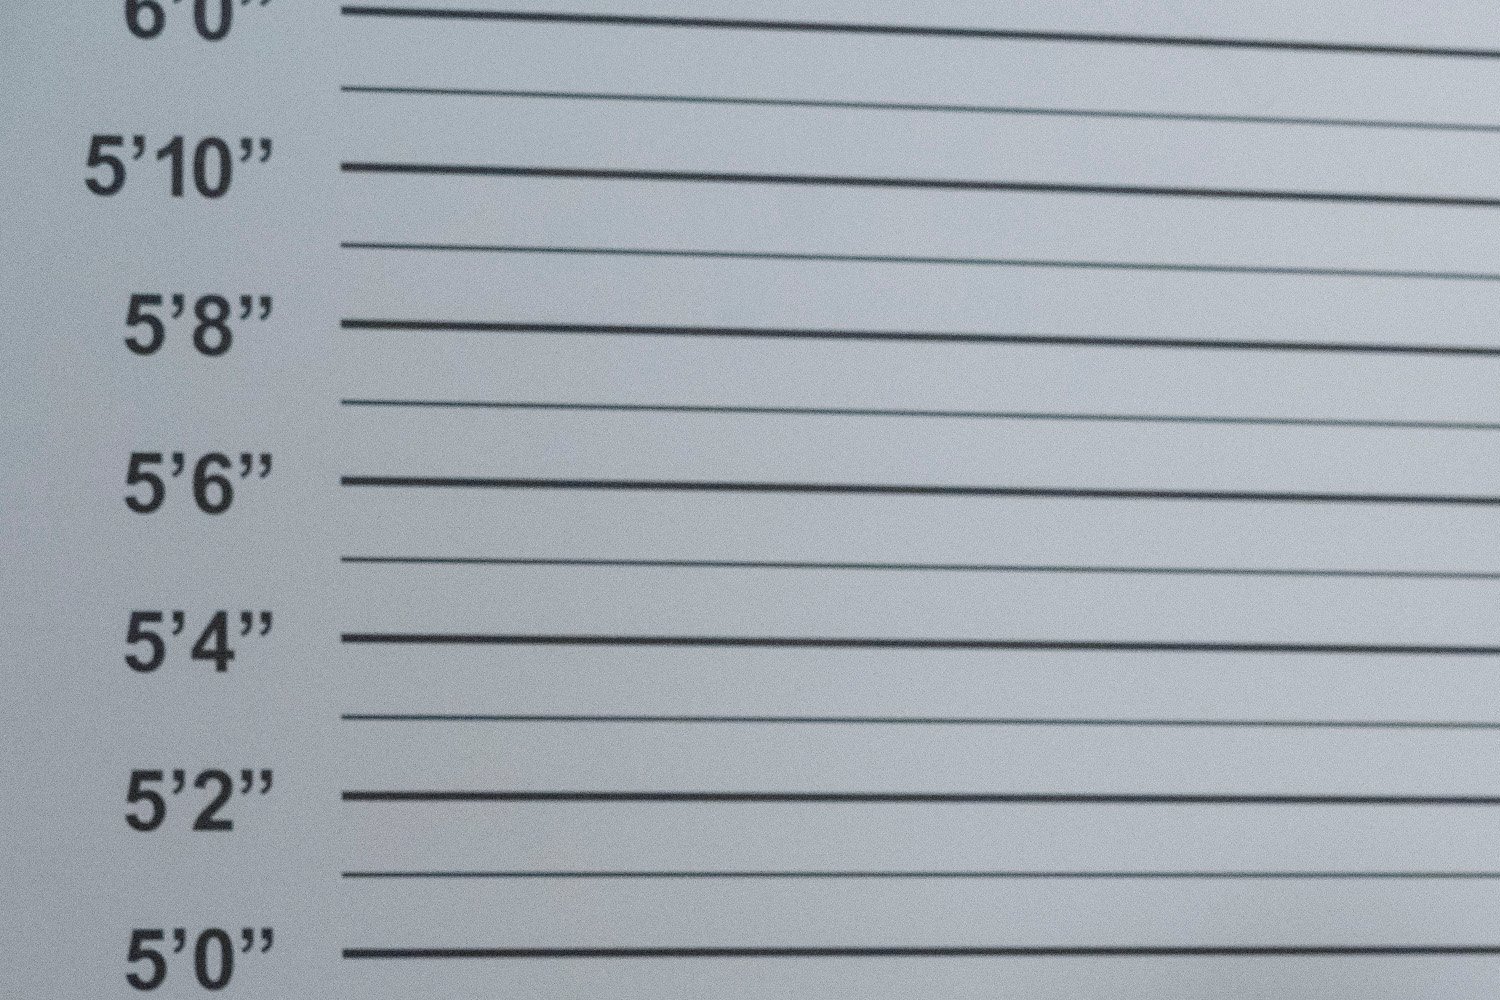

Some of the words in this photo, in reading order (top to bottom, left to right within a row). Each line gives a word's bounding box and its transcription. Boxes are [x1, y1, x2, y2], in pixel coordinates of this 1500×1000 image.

[84, 133, 273, 200] 5’10”
[124, 293, 273, 358] 5’8”
[124, 451, 273, 516] 5’6”
[124, 609, 273, 674] 5’4”
[125, 768, 273, 833] 5’2”
[125, 927, 274, 992] 5’0”
